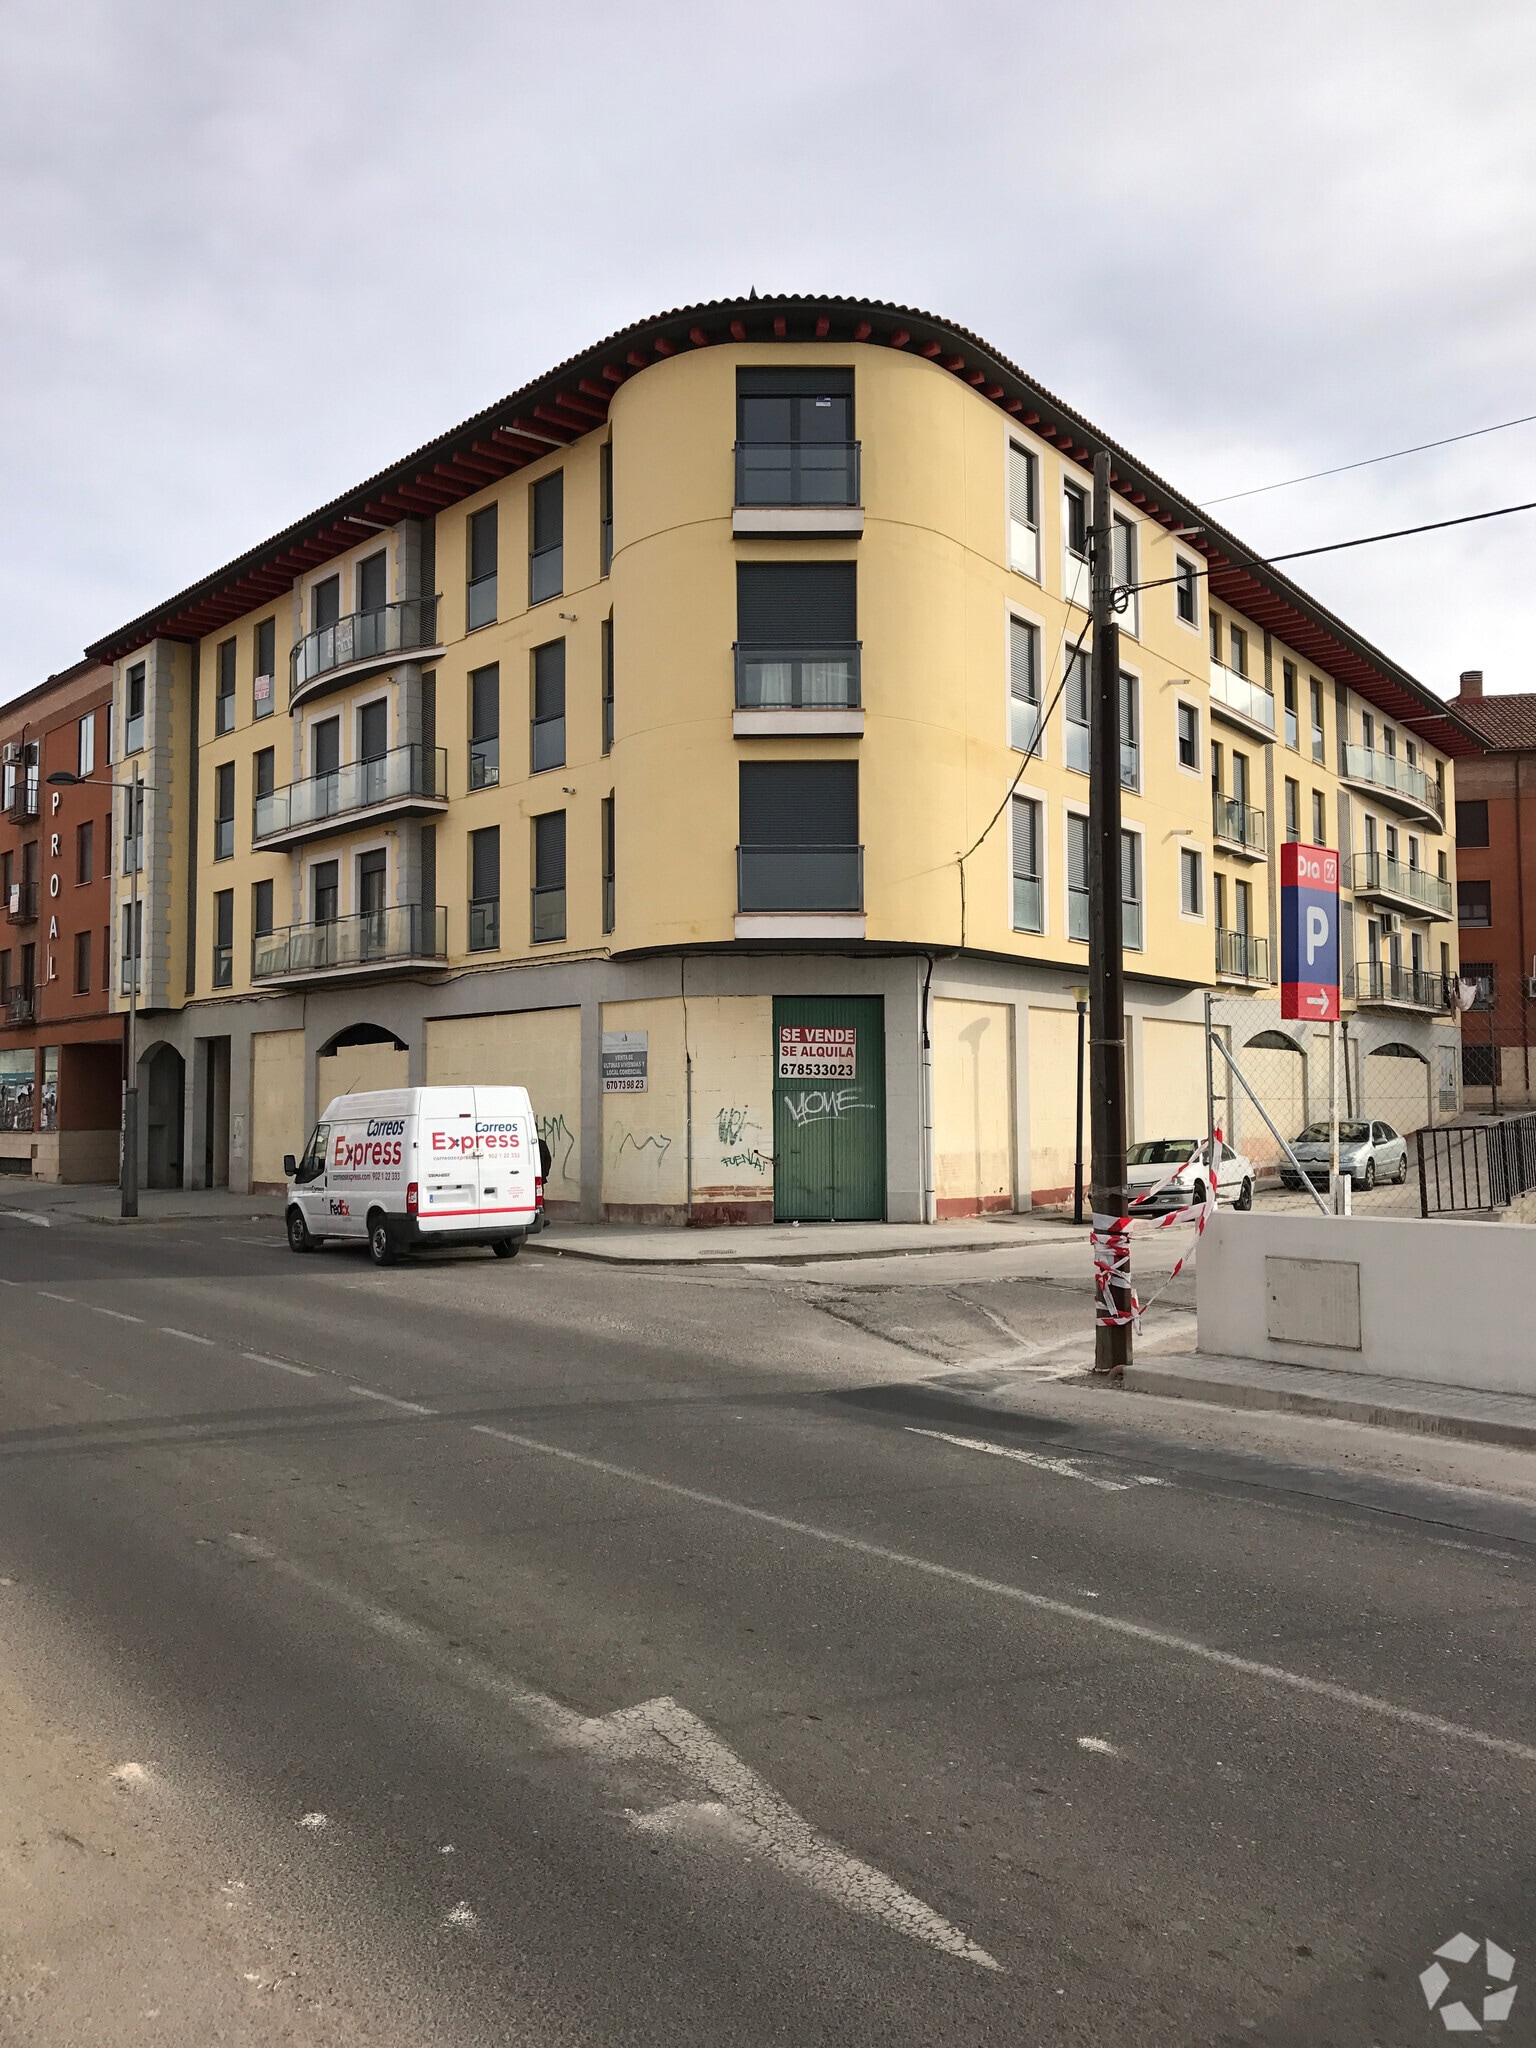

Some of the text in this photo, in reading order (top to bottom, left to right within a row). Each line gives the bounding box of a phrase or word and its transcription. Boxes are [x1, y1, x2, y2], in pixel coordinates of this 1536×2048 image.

[1298, 855, 1320, 879] Dia
[1307, 906, 1329, 966] P
[782, 1028, 854, 1043] SE VENDE
[782, 1046, 854, 1058] SE ALQUILA
[781, 1064, 853, 1076] 678533023
[367, 1119, 405, 1137] Correos
[475, 1122, 518, 1133] Correos
[432, 1132, 519, 1154] Express
[334, 1136, 402, 1171] Express
[330, 1199, 350, 1216] FedEx
